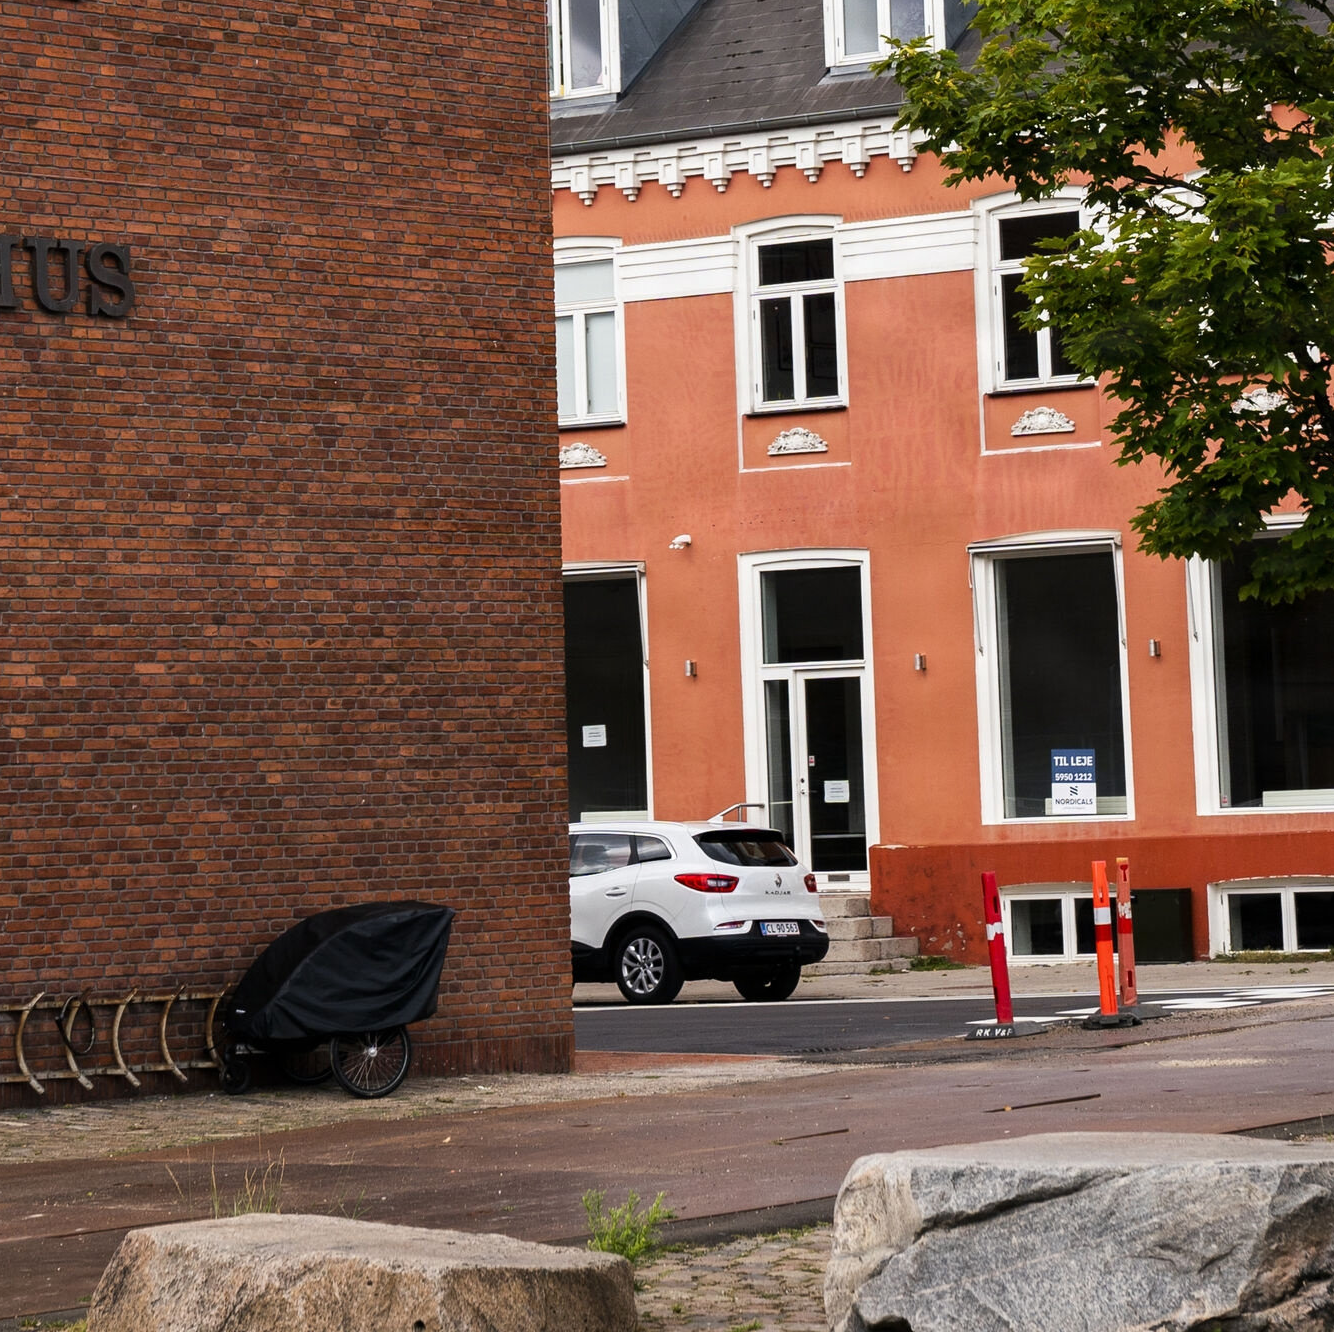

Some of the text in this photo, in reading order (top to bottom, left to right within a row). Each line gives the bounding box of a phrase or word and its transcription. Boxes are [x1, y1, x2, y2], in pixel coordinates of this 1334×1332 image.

[1053, 756, 1093, 766] TIL LEJE
[1055, 773, 1092, 781] 5950 1212
[766, 923, 798, 933] CL 90 563
[976, 1029, 991, 1037] RK
